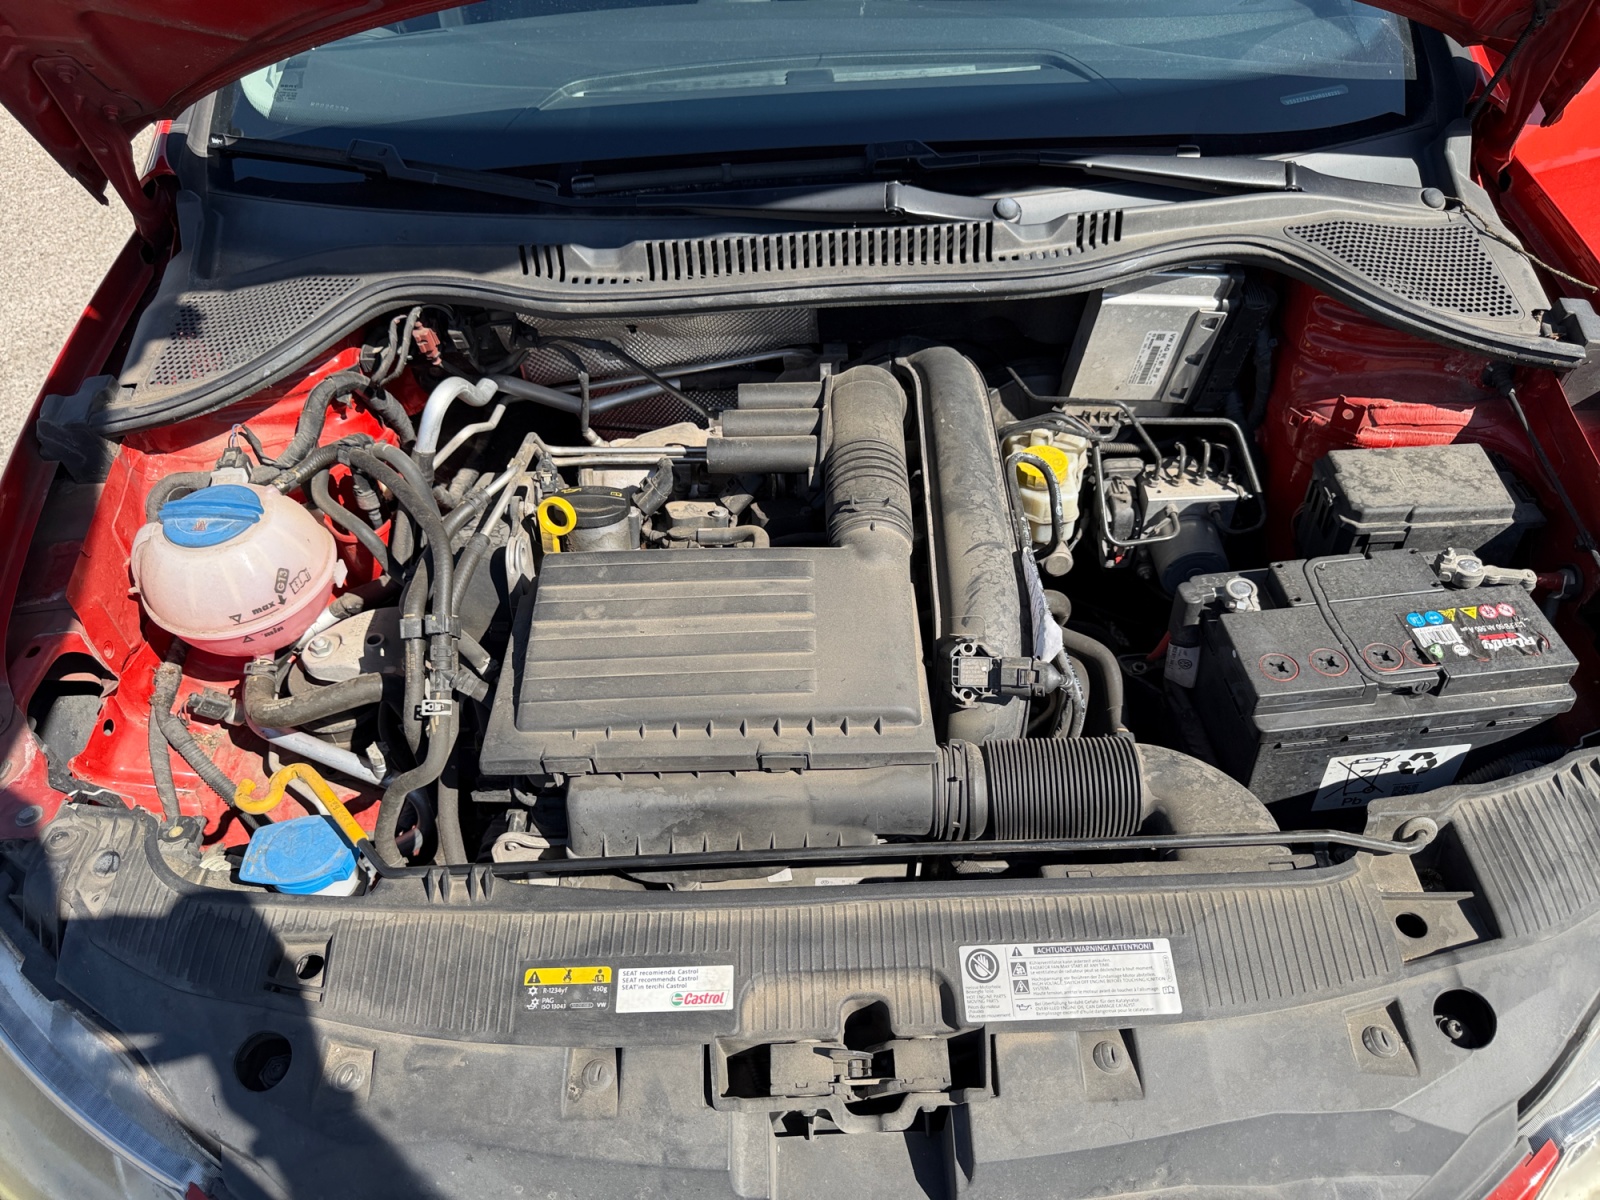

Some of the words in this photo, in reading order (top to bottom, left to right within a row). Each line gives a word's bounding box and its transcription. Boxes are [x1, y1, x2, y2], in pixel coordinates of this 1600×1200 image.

[252, 601, 276, 615] max
[264, 626, 284, 638] min
[1341, 797, 1362, 806] Pb
[1074, 944, 1110, 952] WARNING!
[684, 992, 724, 1005] Castrol
